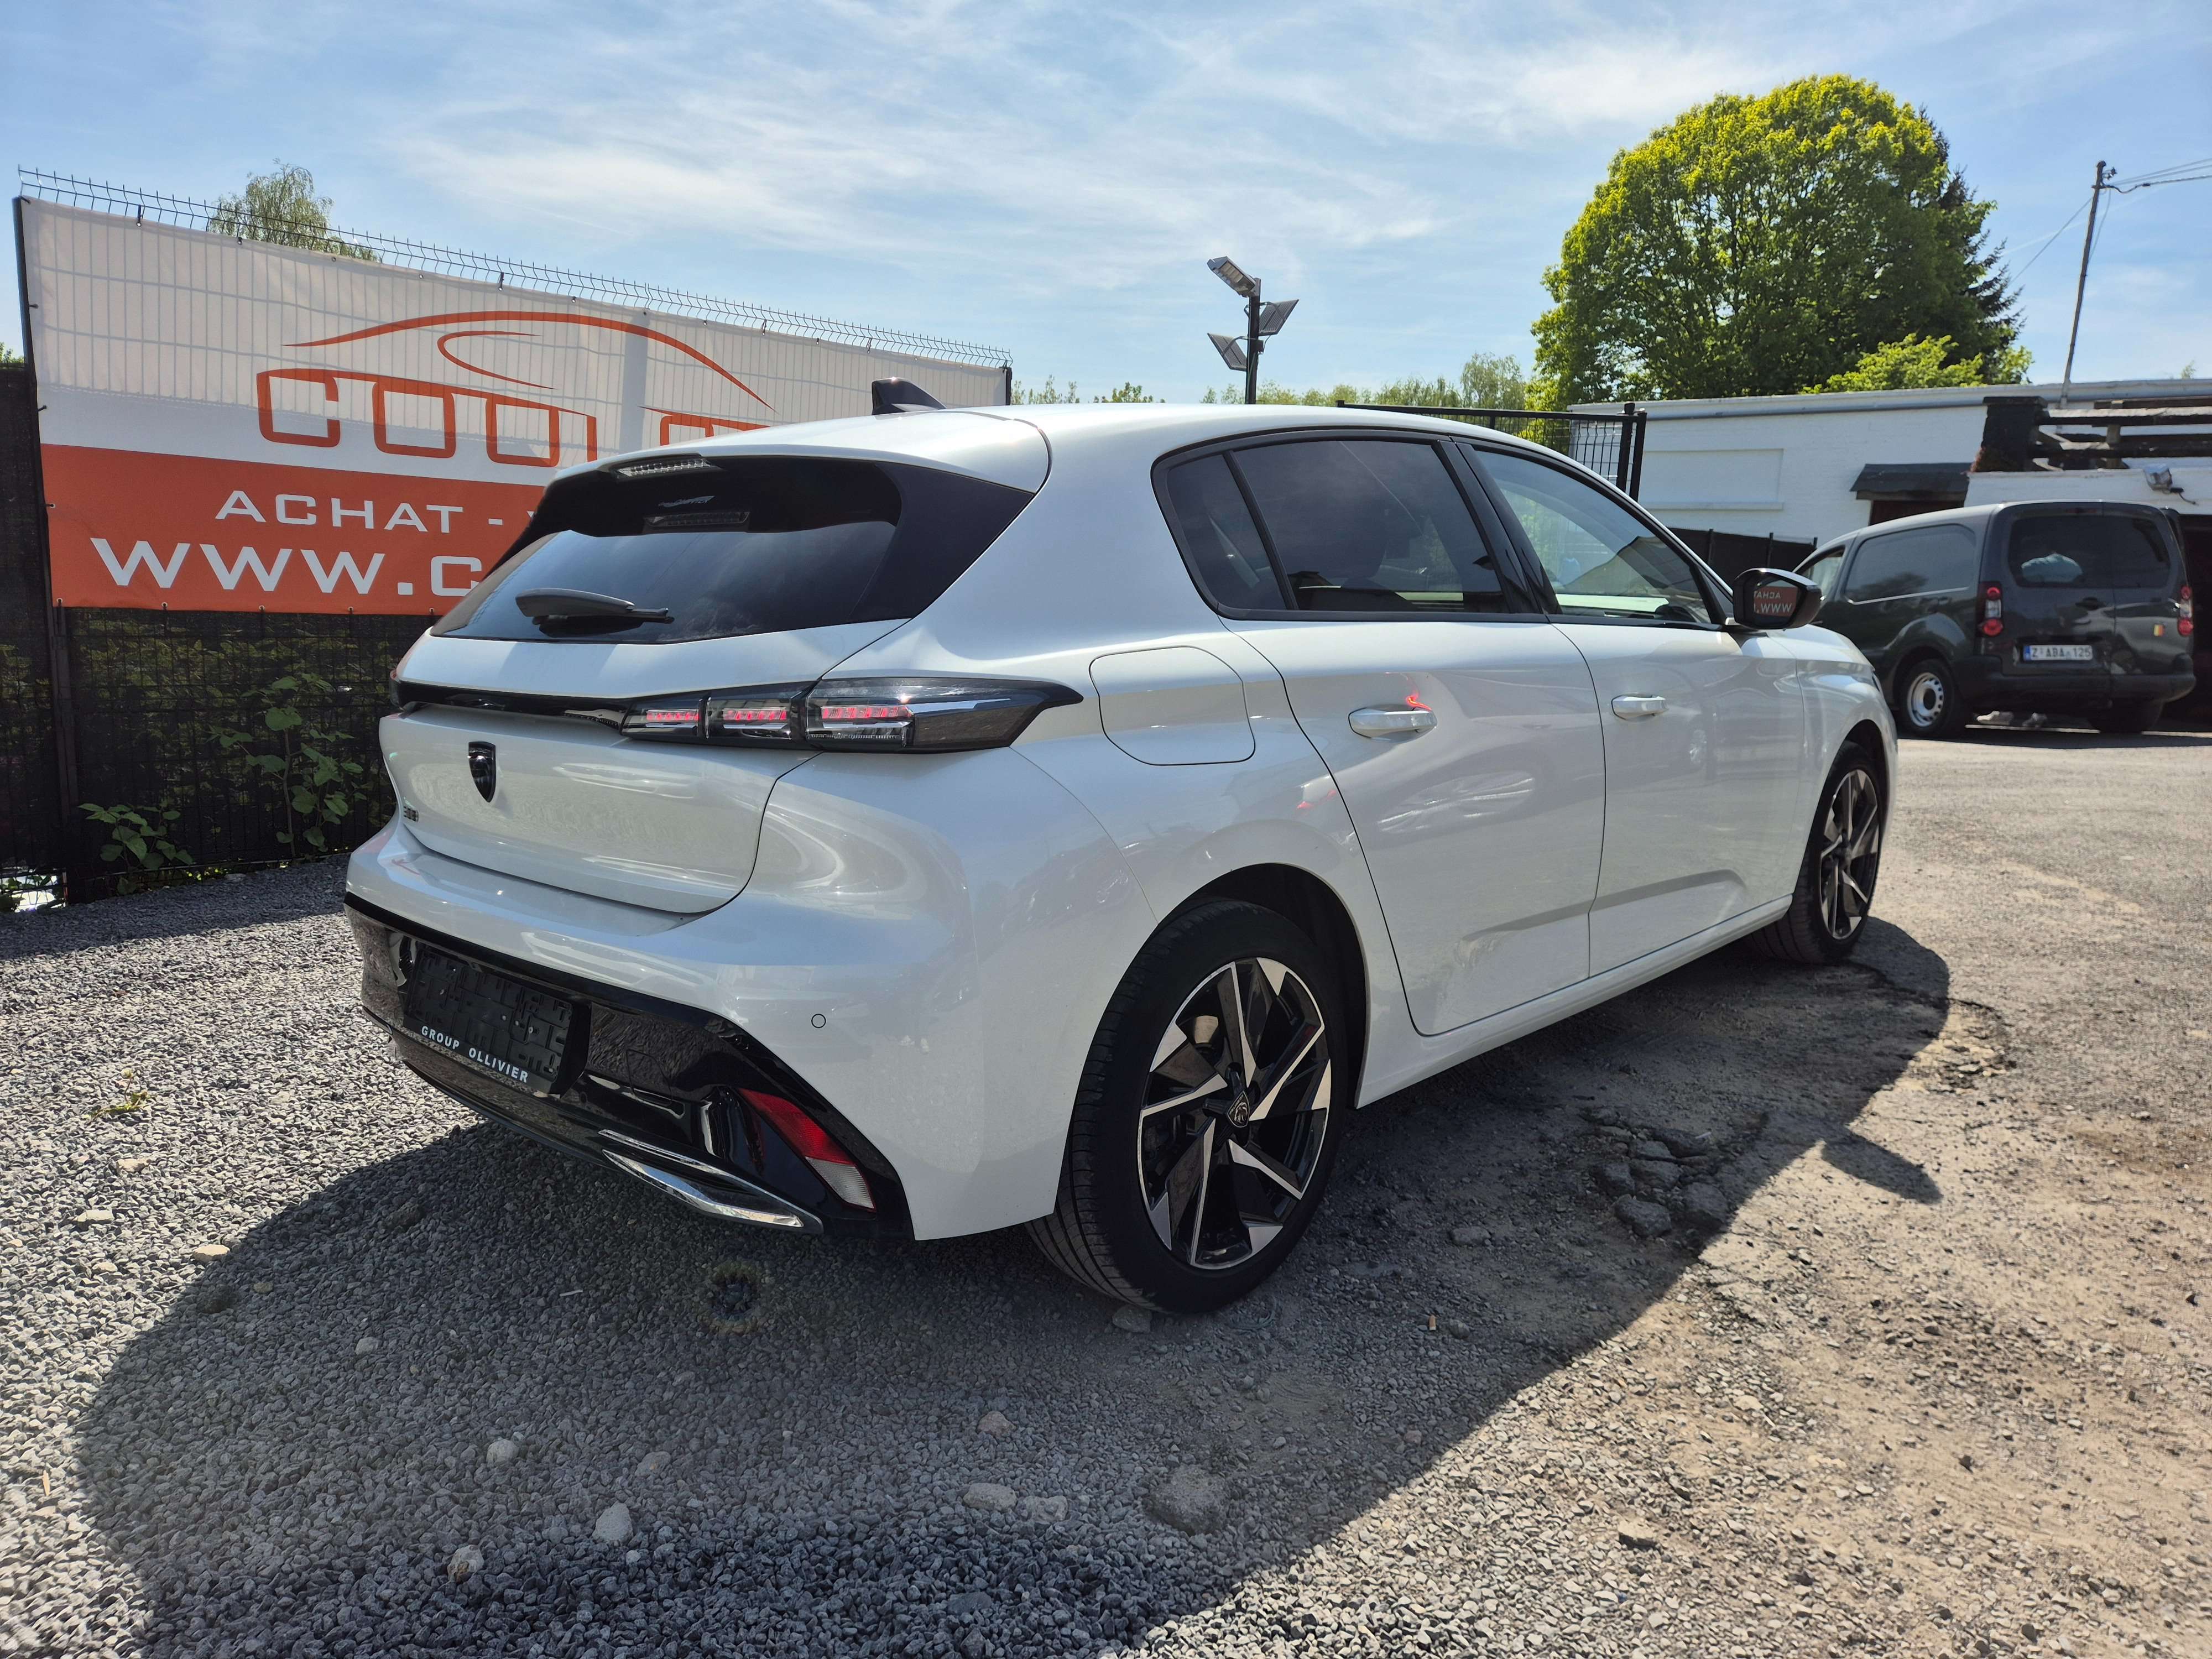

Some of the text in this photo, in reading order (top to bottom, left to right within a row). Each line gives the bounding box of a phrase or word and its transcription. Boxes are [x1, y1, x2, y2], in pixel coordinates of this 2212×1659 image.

[215, 489, 463, 533] ACHAT
[90, 537, 482, 596] WWW.C
[421, 1026, 528, 1083] GROUP OLLIVIER
